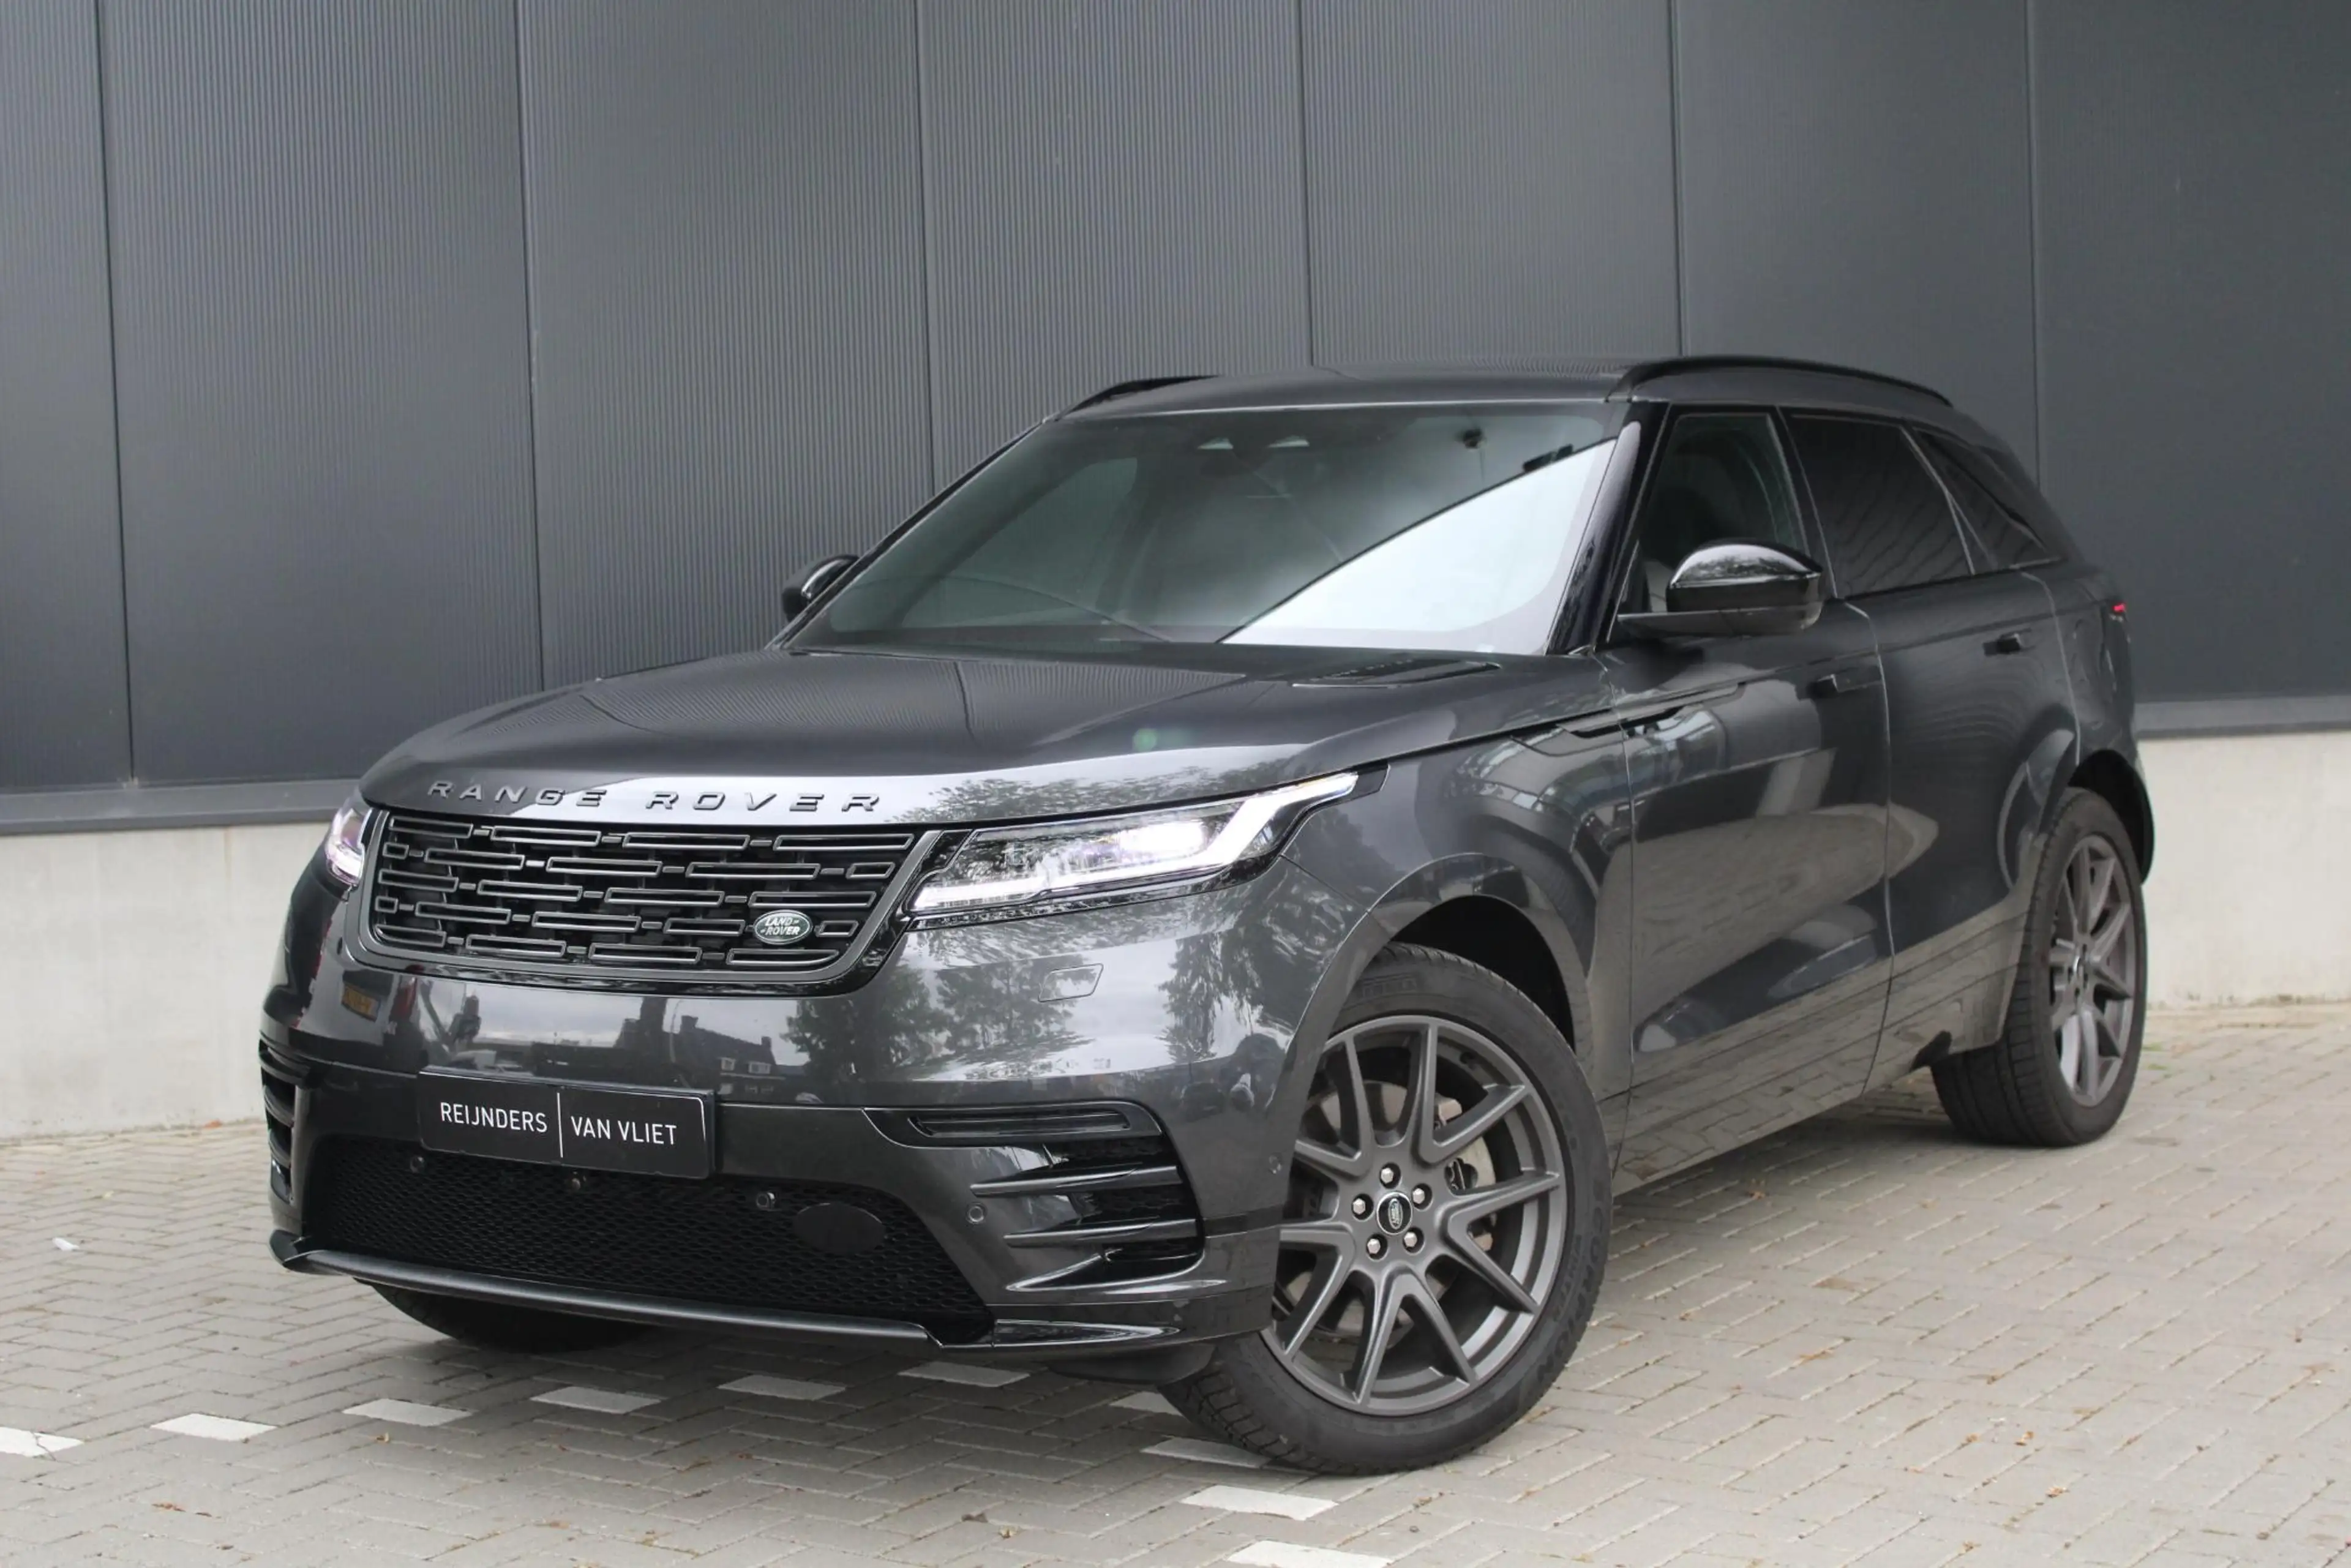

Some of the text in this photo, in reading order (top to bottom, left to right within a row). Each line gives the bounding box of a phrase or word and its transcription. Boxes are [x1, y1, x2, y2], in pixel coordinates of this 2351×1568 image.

[427, 781, 880, 812] RANGE ROVER
[765, 917, 793, 926] LAND
[765, 926, 800, 936] ROVER
[440, 1102, 677, 1146] REIJNDERS VAN VLIET
